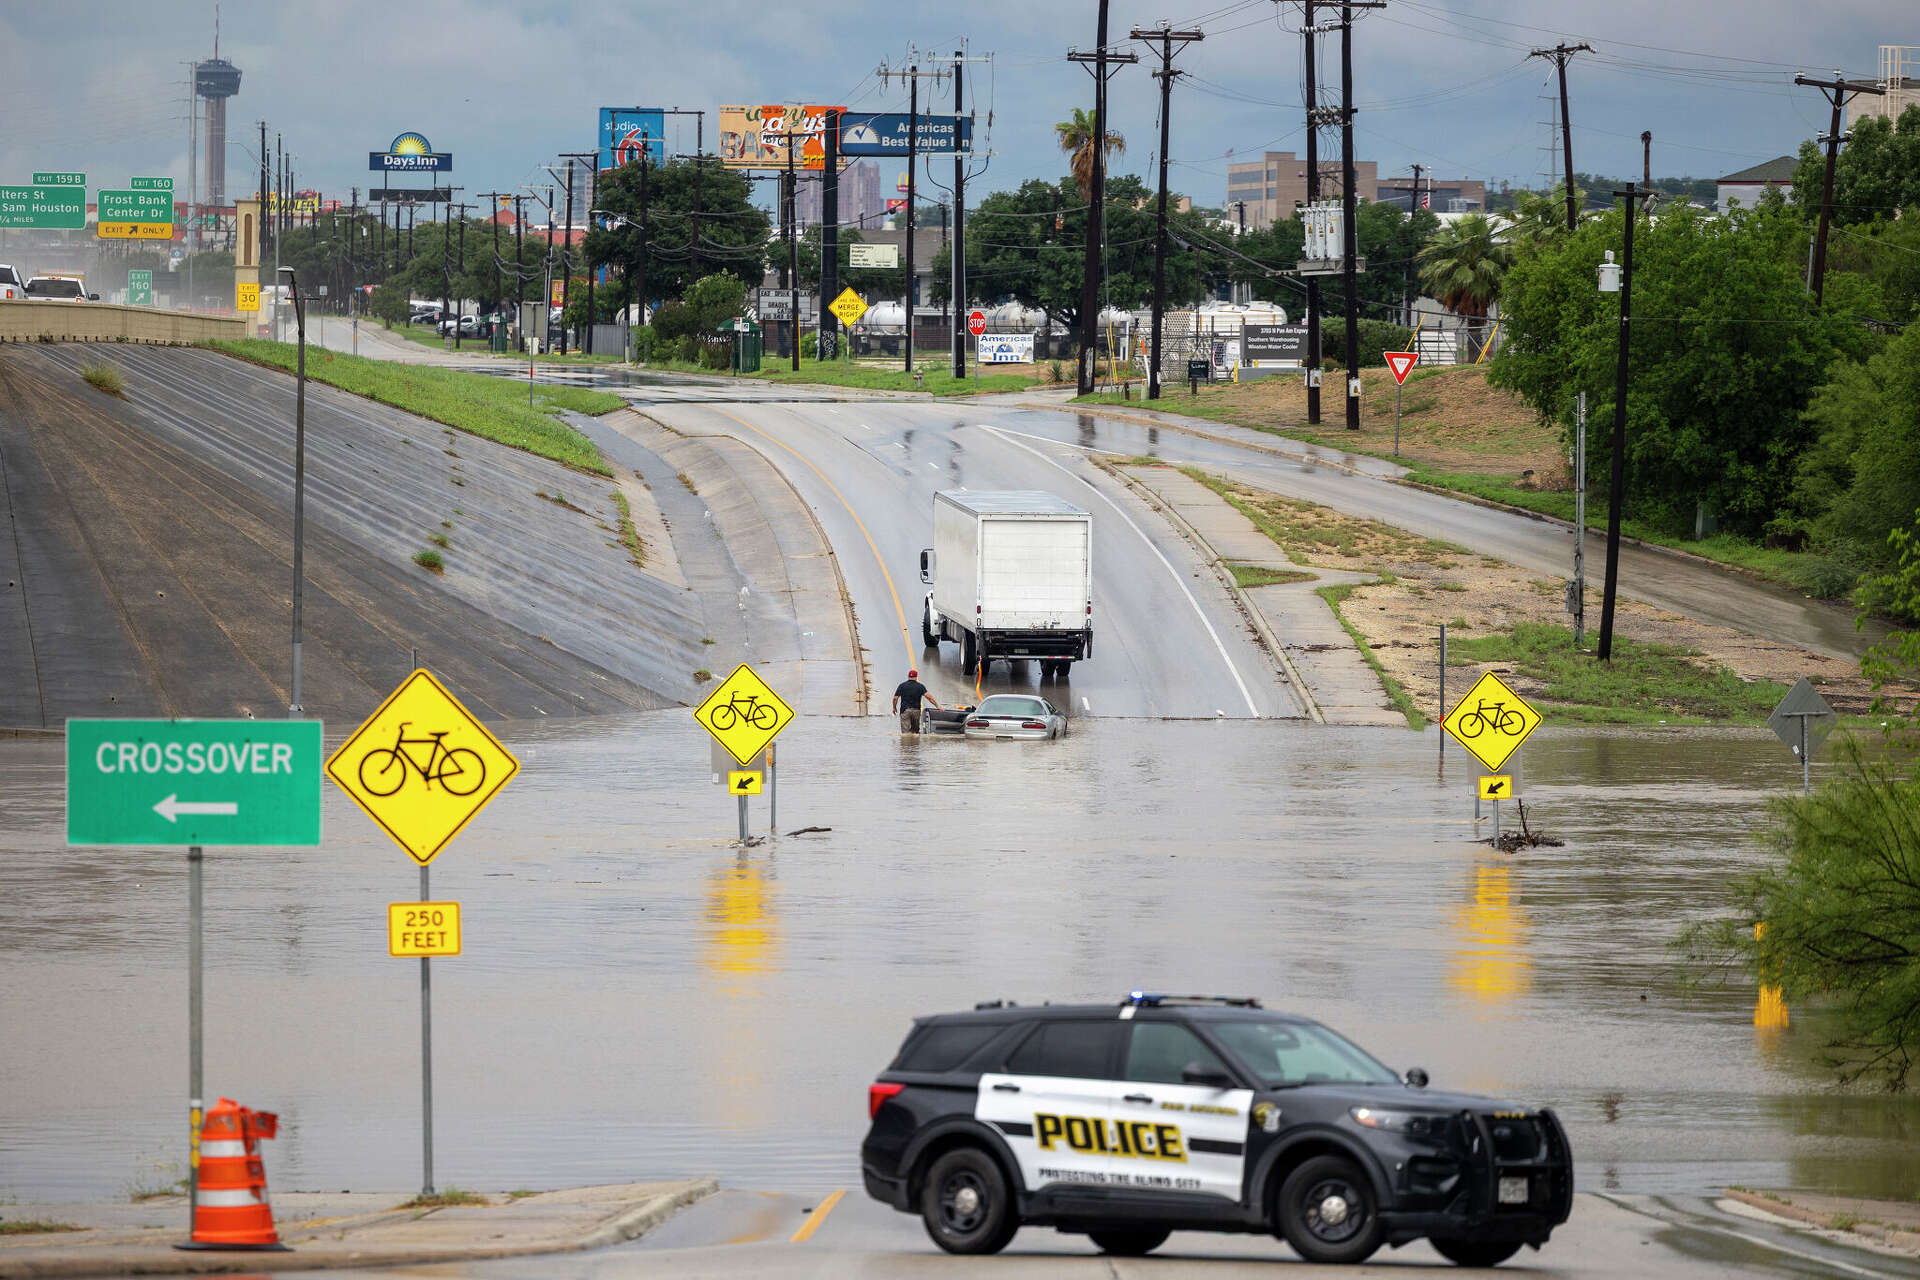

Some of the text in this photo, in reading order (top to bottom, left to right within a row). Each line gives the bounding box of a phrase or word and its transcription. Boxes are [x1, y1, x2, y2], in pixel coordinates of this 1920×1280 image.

[882, 136, 970, 147] Best Value In
[384, 155, 438, 167] Days Inn
[56, 175, 73, 184] 159
[152, 180, 171, 188] 160
[1, 190, 45, 200] lters St
[103, 195, 167, 205] Frost Bank
[2, 203, 80, 213] Sam Houston
[106, 208, 164, 218] Center Dr
[131, 281, 149, 290] 160
[241, 294, 256, 303] 30
[969, 318, 985, 329] STOP
[980, 343, 994, 353] Best
[993, 352, 1020, 361] Inn
[96, 742, 293, 774] CROSSOVER
[405, 911, 444, 927] 250
[402, 932, 448, 949] FEET
[1035, 1113, 1187, 1163] POLICE
[1038, 1167, 1105, 1184] PROTECTING
[1109, 1173, 1130, 1185] THE
